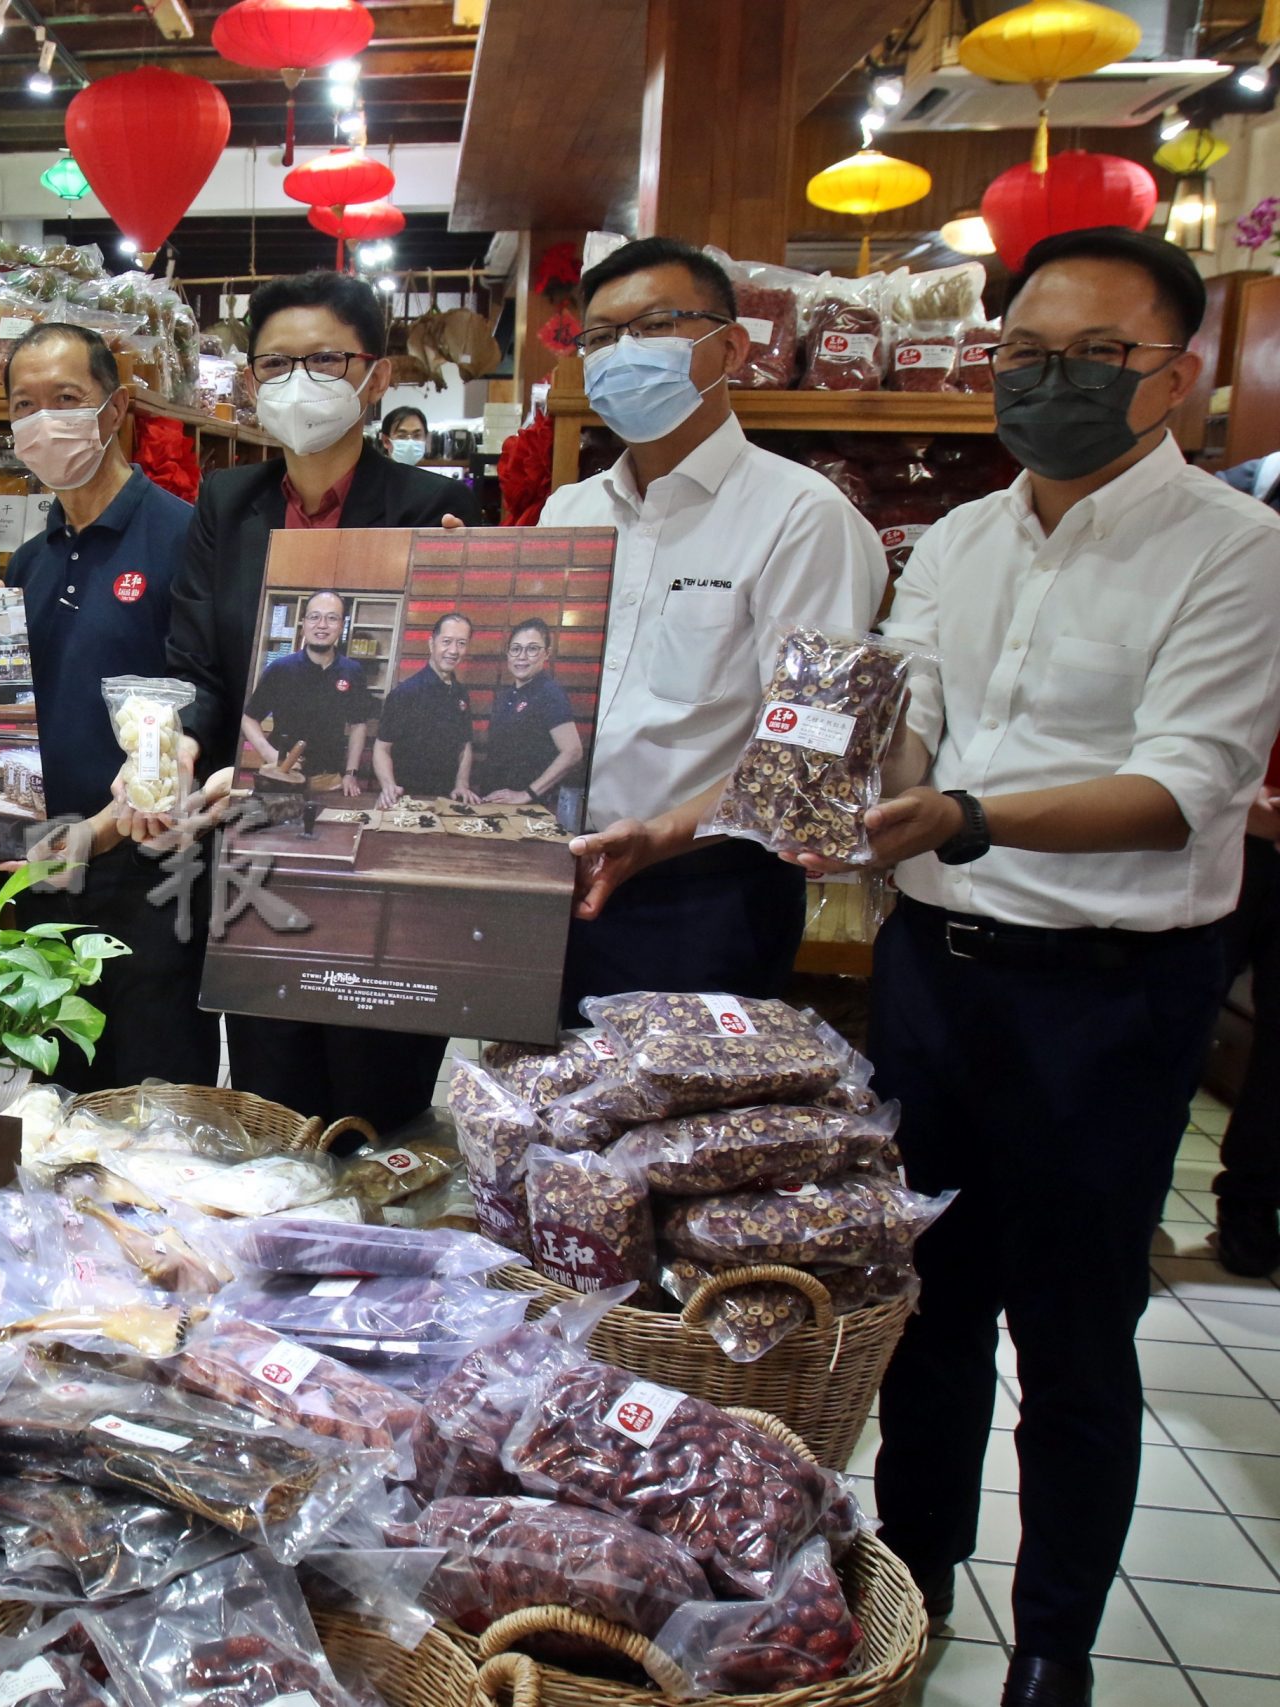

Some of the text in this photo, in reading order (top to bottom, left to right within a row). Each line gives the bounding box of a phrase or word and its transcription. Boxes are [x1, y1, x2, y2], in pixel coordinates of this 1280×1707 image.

[120, 573, 142, 588] 正和
[683, 577, 732, 589] TEH LAI HENG
[772, 708, 794, 722] 正和
[300, 984, 345, 993] PENGIKTIRAFAN
[362, 978, 404, 987] RECOGNITION
[542, 1230, 595, 1271] 正和
[543, 1264, 602, 1294] CHENG WOH
